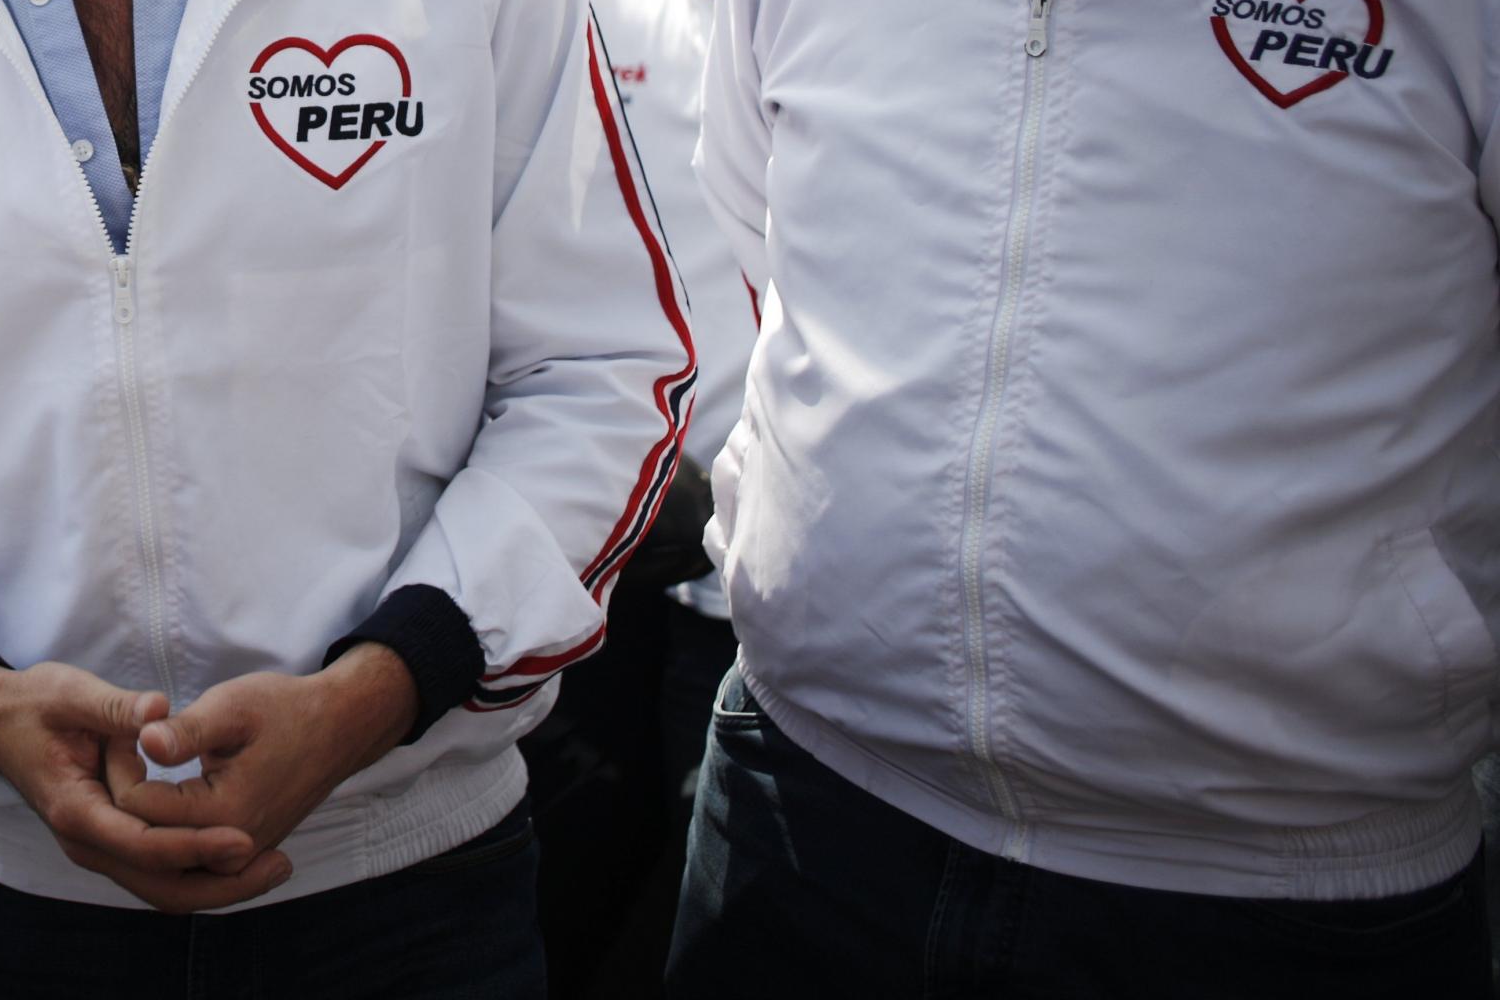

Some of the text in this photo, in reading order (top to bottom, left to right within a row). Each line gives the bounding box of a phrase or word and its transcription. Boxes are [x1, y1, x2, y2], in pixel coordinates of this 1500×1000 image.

[1250, 29, 1394, 80] PERU
[247, 73, 356, 100] SOMOS
[296, 100, 424, 143] PERU
